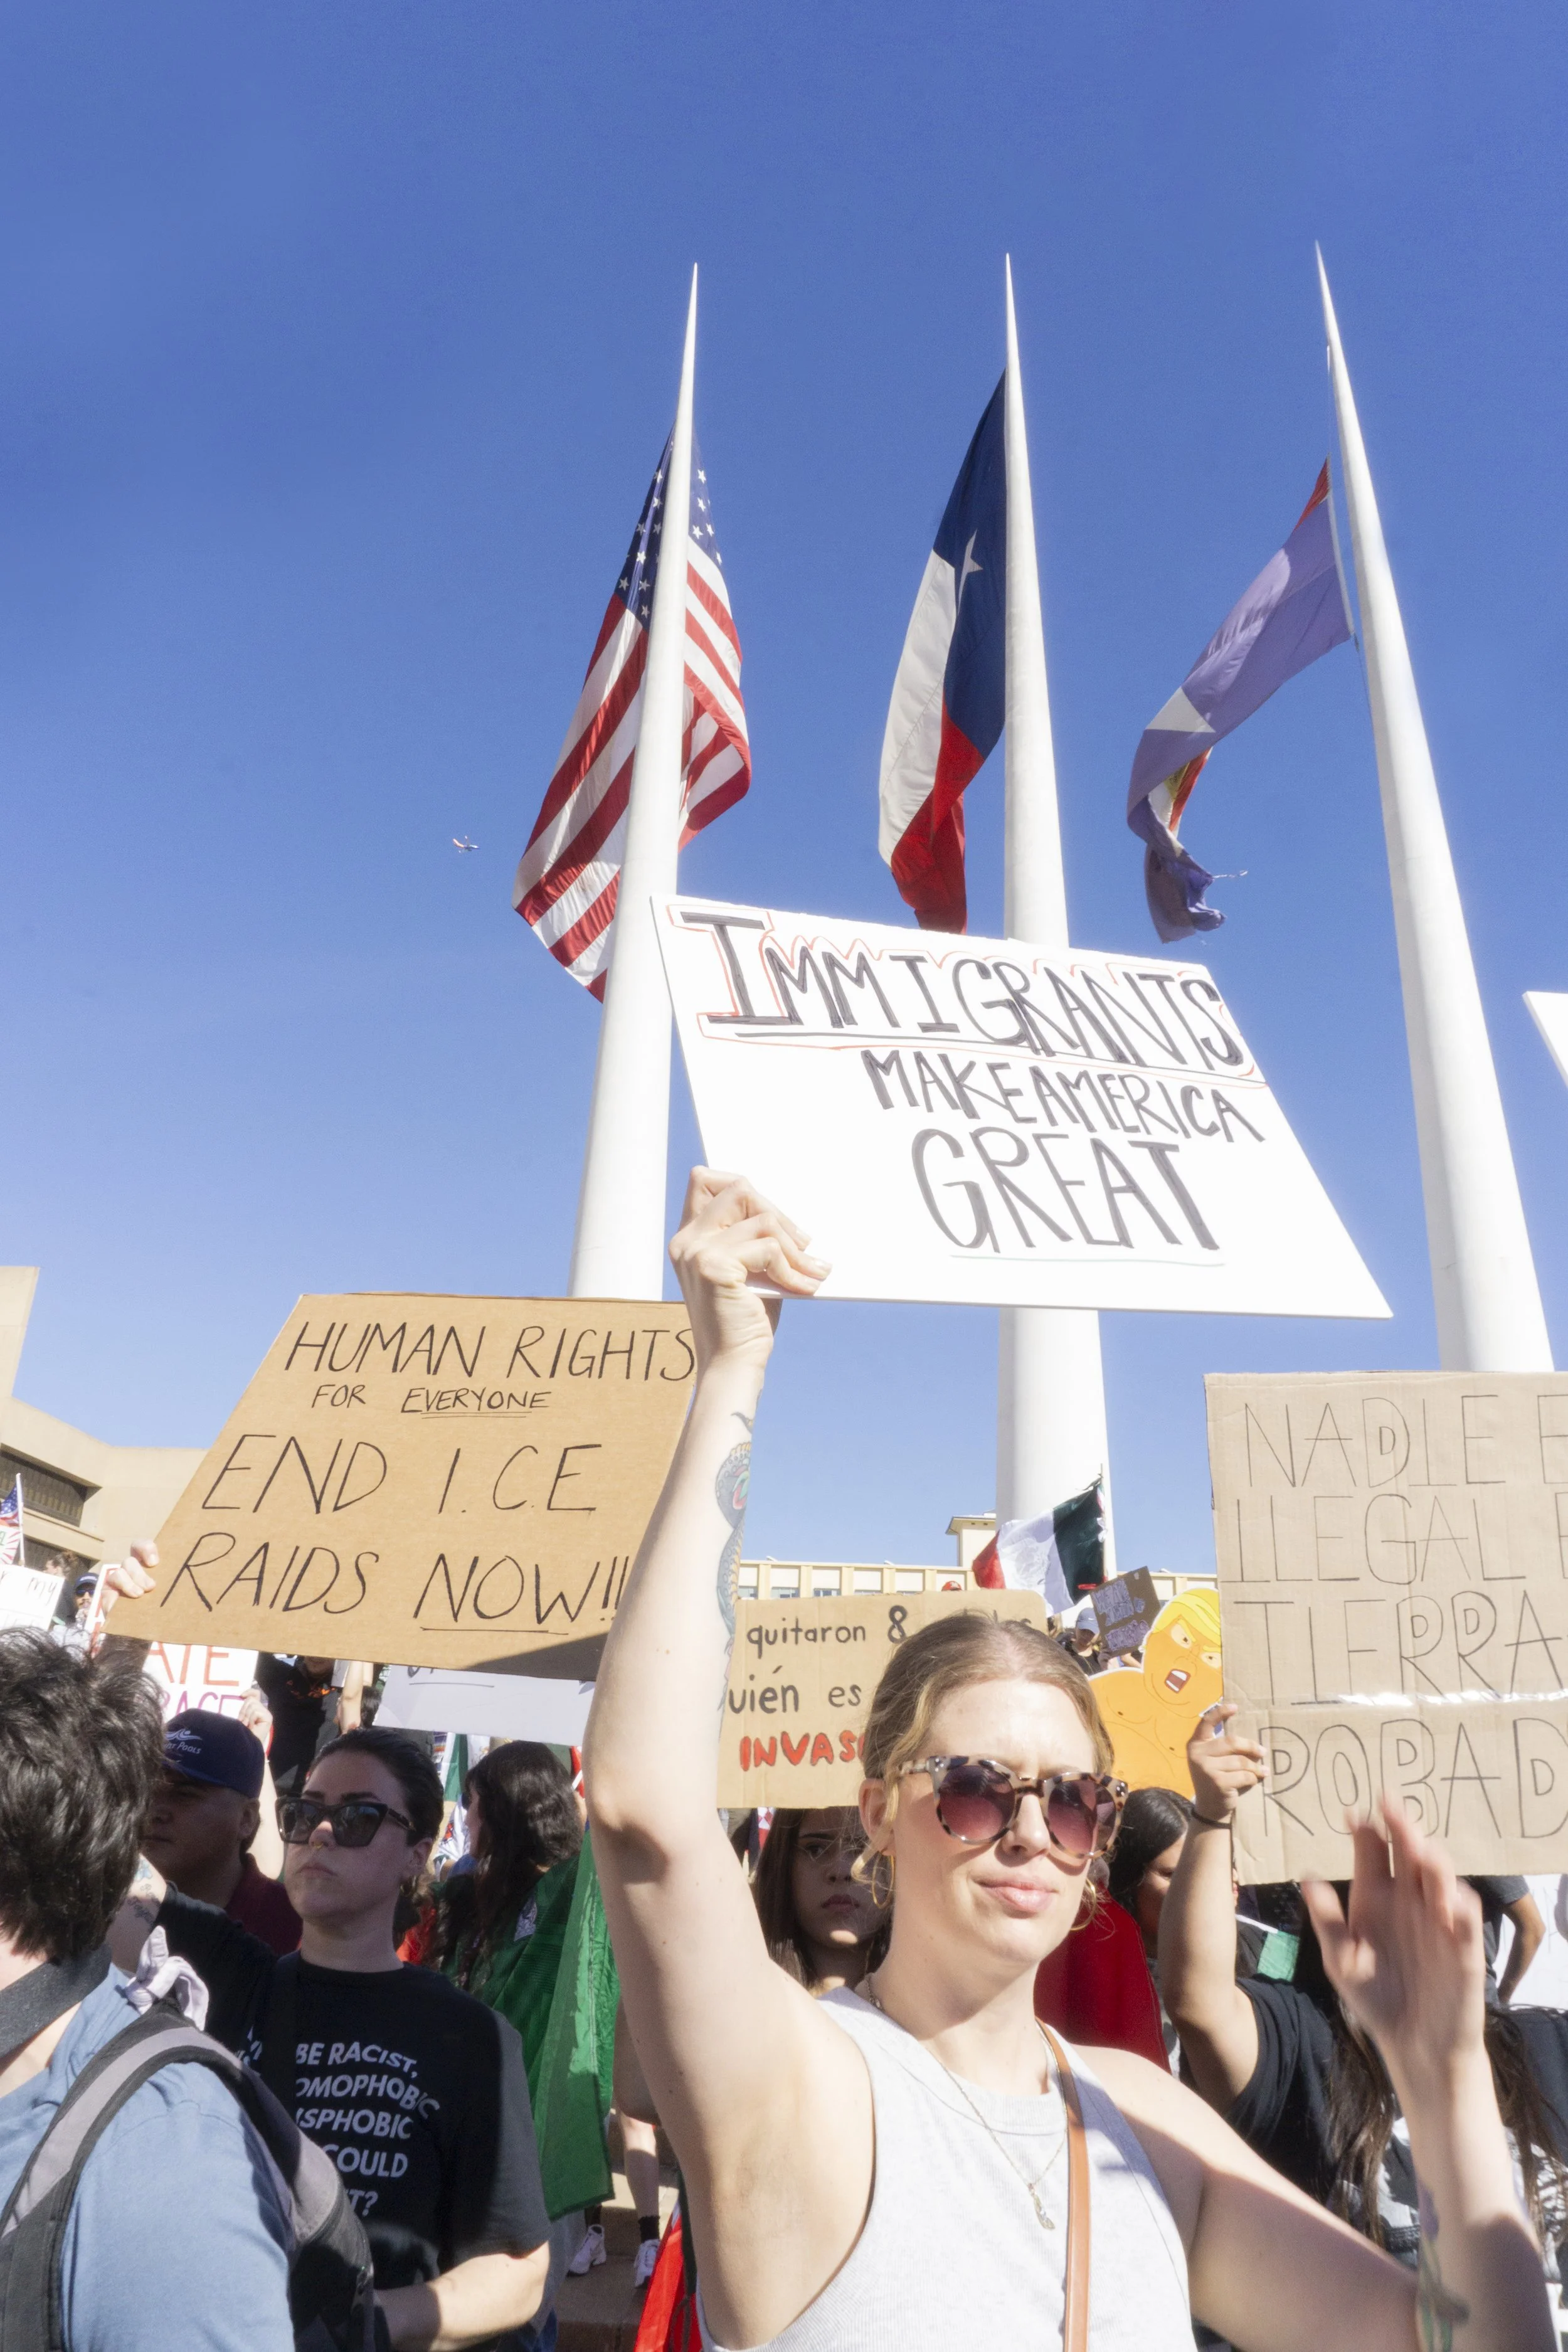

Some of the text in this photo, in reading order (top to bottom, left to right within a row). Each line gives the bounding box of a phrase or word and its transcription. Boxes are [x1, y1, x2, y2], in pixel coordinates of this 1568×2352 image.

[681, 911, 1244, 1071] IMMIGRANTS
[861, 1049, 1266, 1143] MAKE AMERICA
[911, 1126, 1220, 1254] GREAT
[285, 1322, 695, 1381] HUMAN RIGHTS
[312, 1384, 552, 1414] FOR EVERYONE
[1244, 1394, 1507, 1488] NADIE
[202, 1434, 387, 1514] END
[160, 1532, 379, 1614] RAIDS
[414, 1553, 629, 1623] NOW!!
[1220, 1493, 1527, 1585] ILEGAL
[746, 1604, 908, 1659] quitaron 8
[1233, 1590, 1562, 1705] TIERRA
[728, 1665, 862, 1714] uién es
[295, 2043, 325, 2065] BE
[327, 2042, 418, 2078] RACIST,
[295, 2075, 440, 2119] OMOPHOBIC
